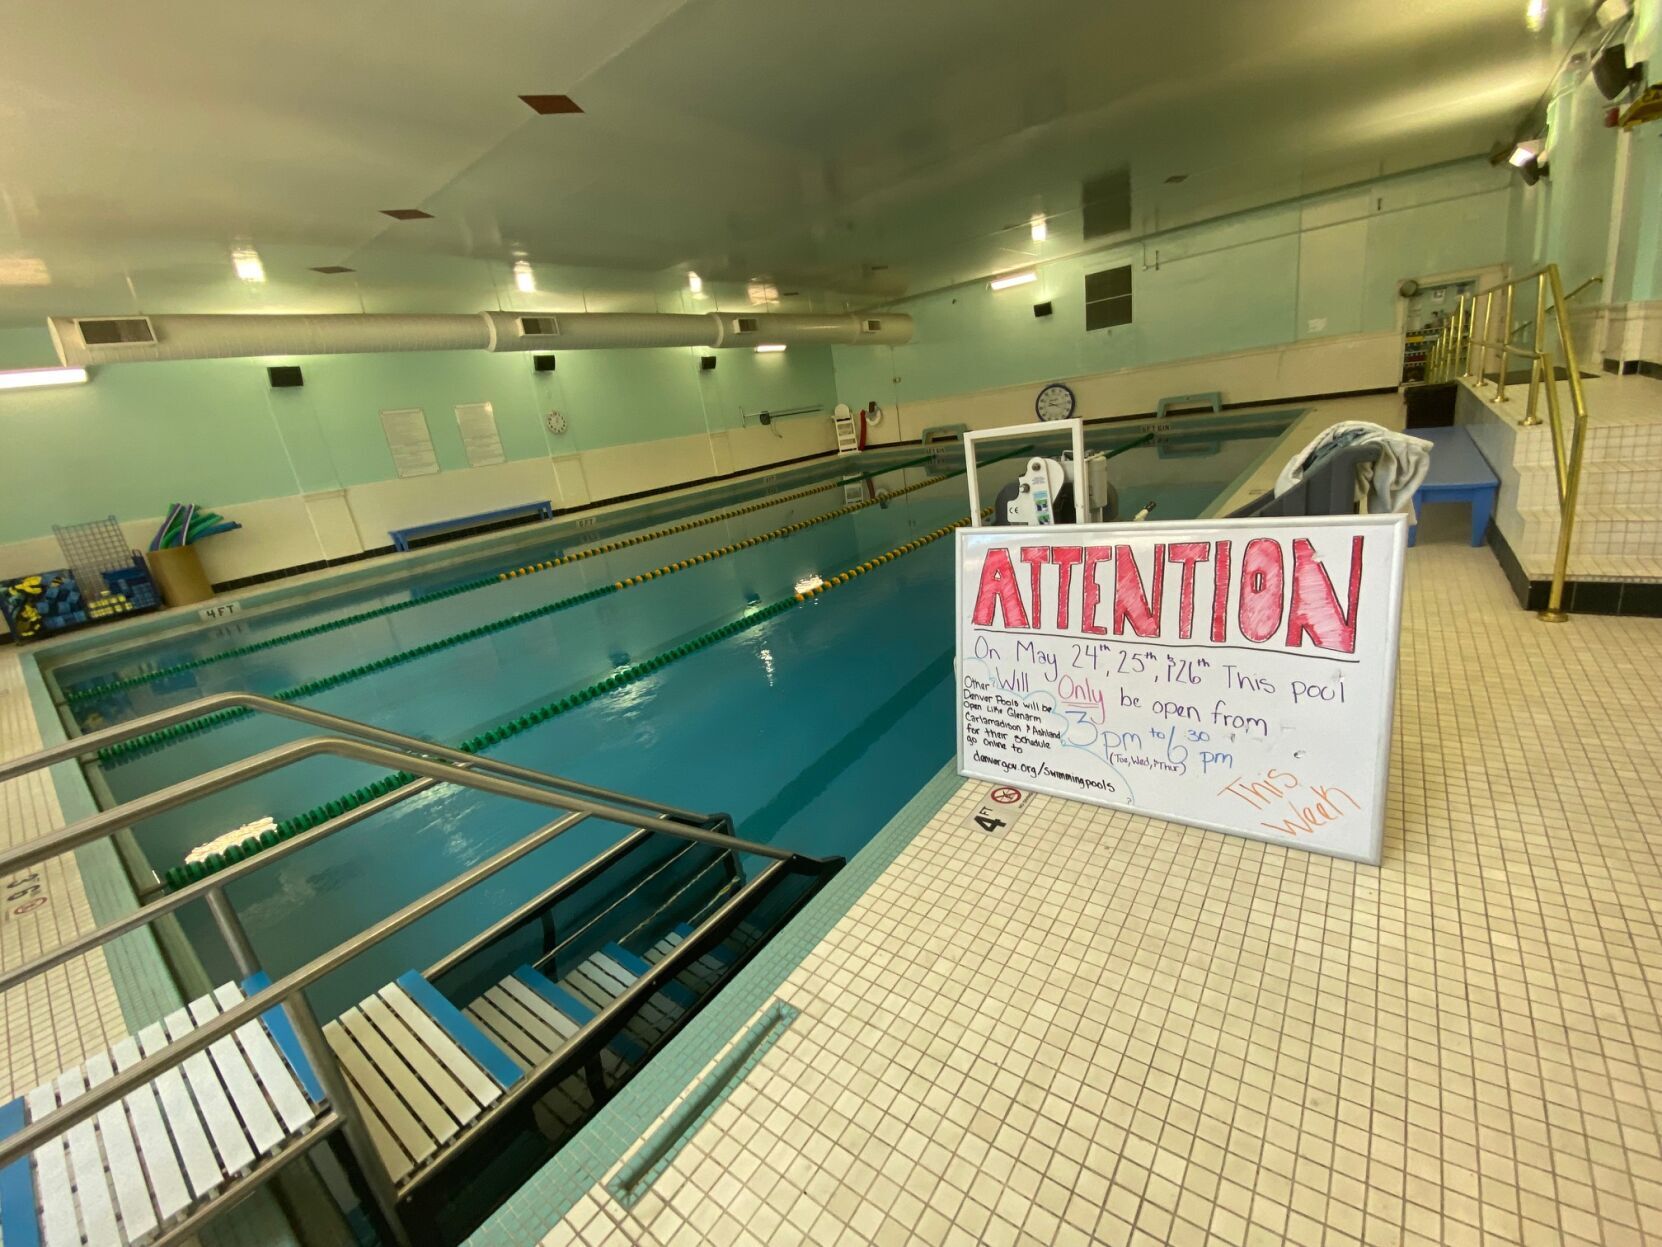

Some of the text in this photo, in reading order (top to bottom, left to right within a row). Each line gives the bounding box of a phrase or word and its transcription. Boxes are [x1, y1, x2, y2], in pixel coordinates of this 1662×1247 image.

[971, 535, 1364, 654] ATTENTION
[974, 636, 1001, 660] On
[1016, 641, 1058, 682] May
[1222, 664, 1276, 693] This
[1291, 680, 1345, 703] pool
[964, 675, 990, 690] Other
[963, 689, 1052, 712] Denver Pools will be
[996, 666, 1268, 736] Will Only be open from
[1007, 707, 1041, 723] Glenarm
[967, 723, 980, 735] for
[985, 727, 1008, 740] their
[1033, 726, 1060, 740] Ashland
[1065, 711, 1098, 746] 3
[1102, 730, 1142, 760] pm
[1149, 727, 1165, 739] to
[1200, 751, 1233, 773] pm
[967, 735, 977, 746] go
[1011, 744, 1023, 754] to
[1217, 769, 1298, 810] This
[974, 815, 1007, 832] 4
